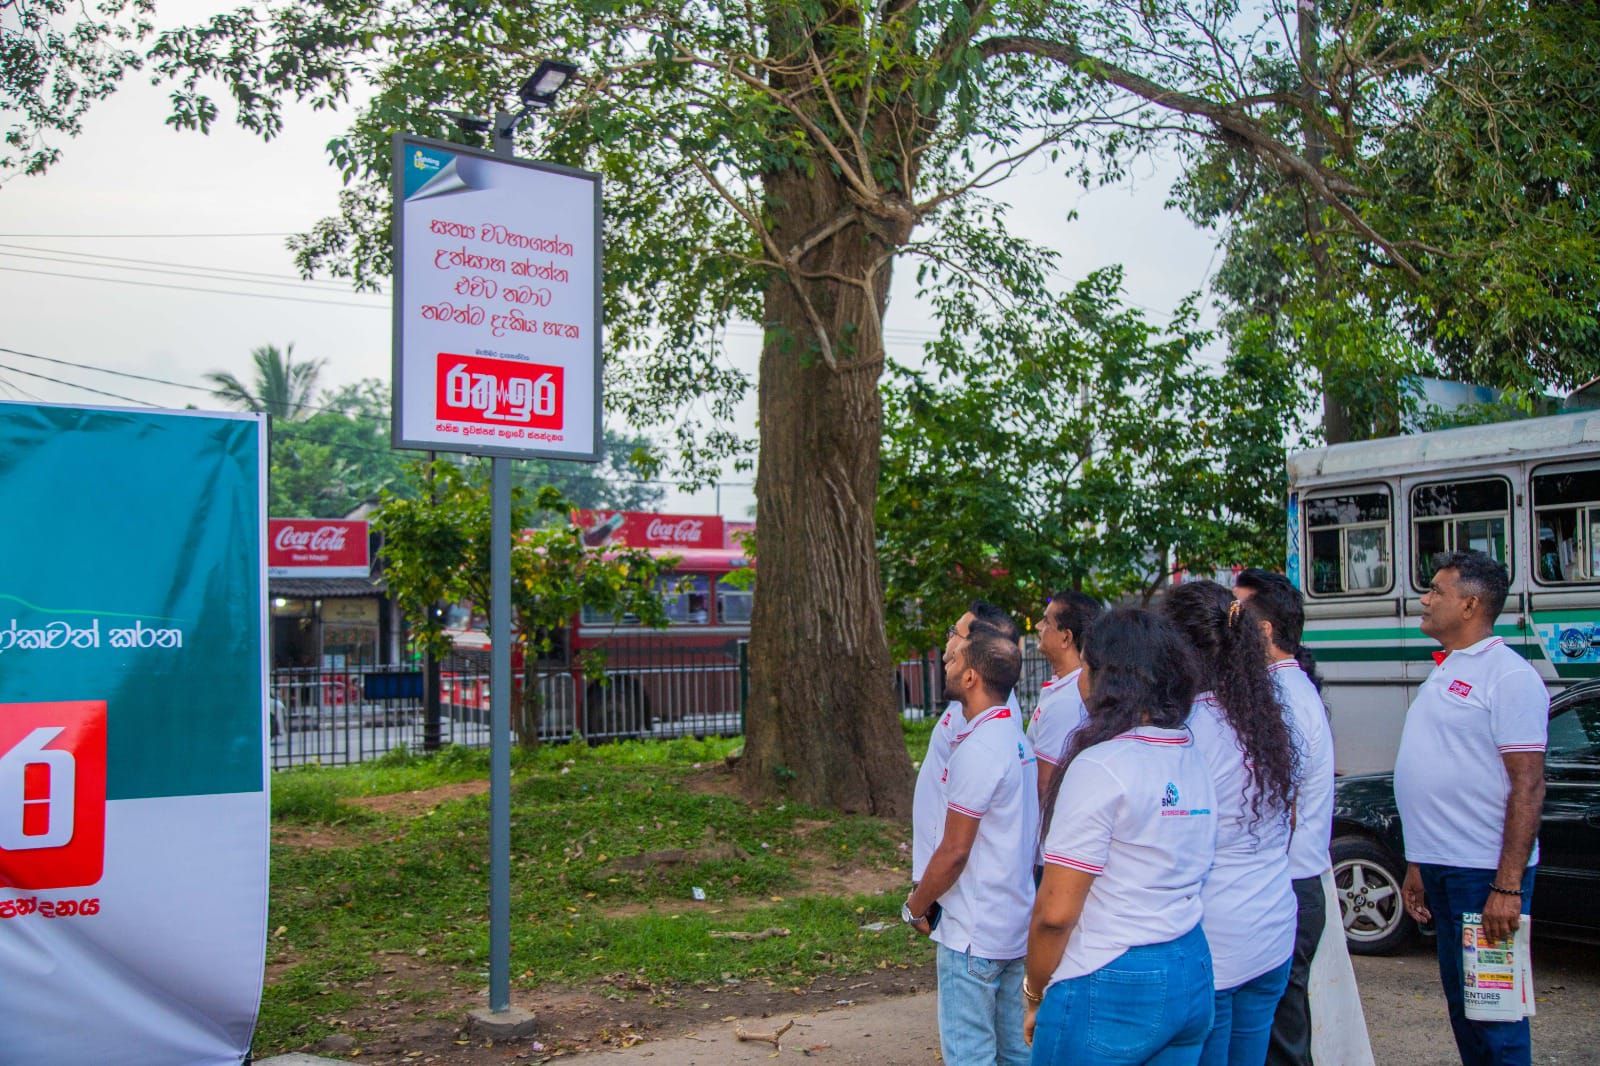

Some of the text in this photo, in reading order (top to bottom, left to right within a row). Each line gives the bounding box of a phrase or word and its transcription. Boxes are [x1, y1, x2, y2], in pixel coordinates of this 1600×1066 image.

[434, 245, 569, 283] උත්සාහ කරන්න
[454, 275, 498, 299] එවිට
[490, 308, 538, 338] දැකිය
[542, 320, 580, 339] හැක
[275, 525, 349, 551] Coca-Cola
[646, 518, 704, 542] Coca-Cola
[108, 620, 183, 649] කරන
